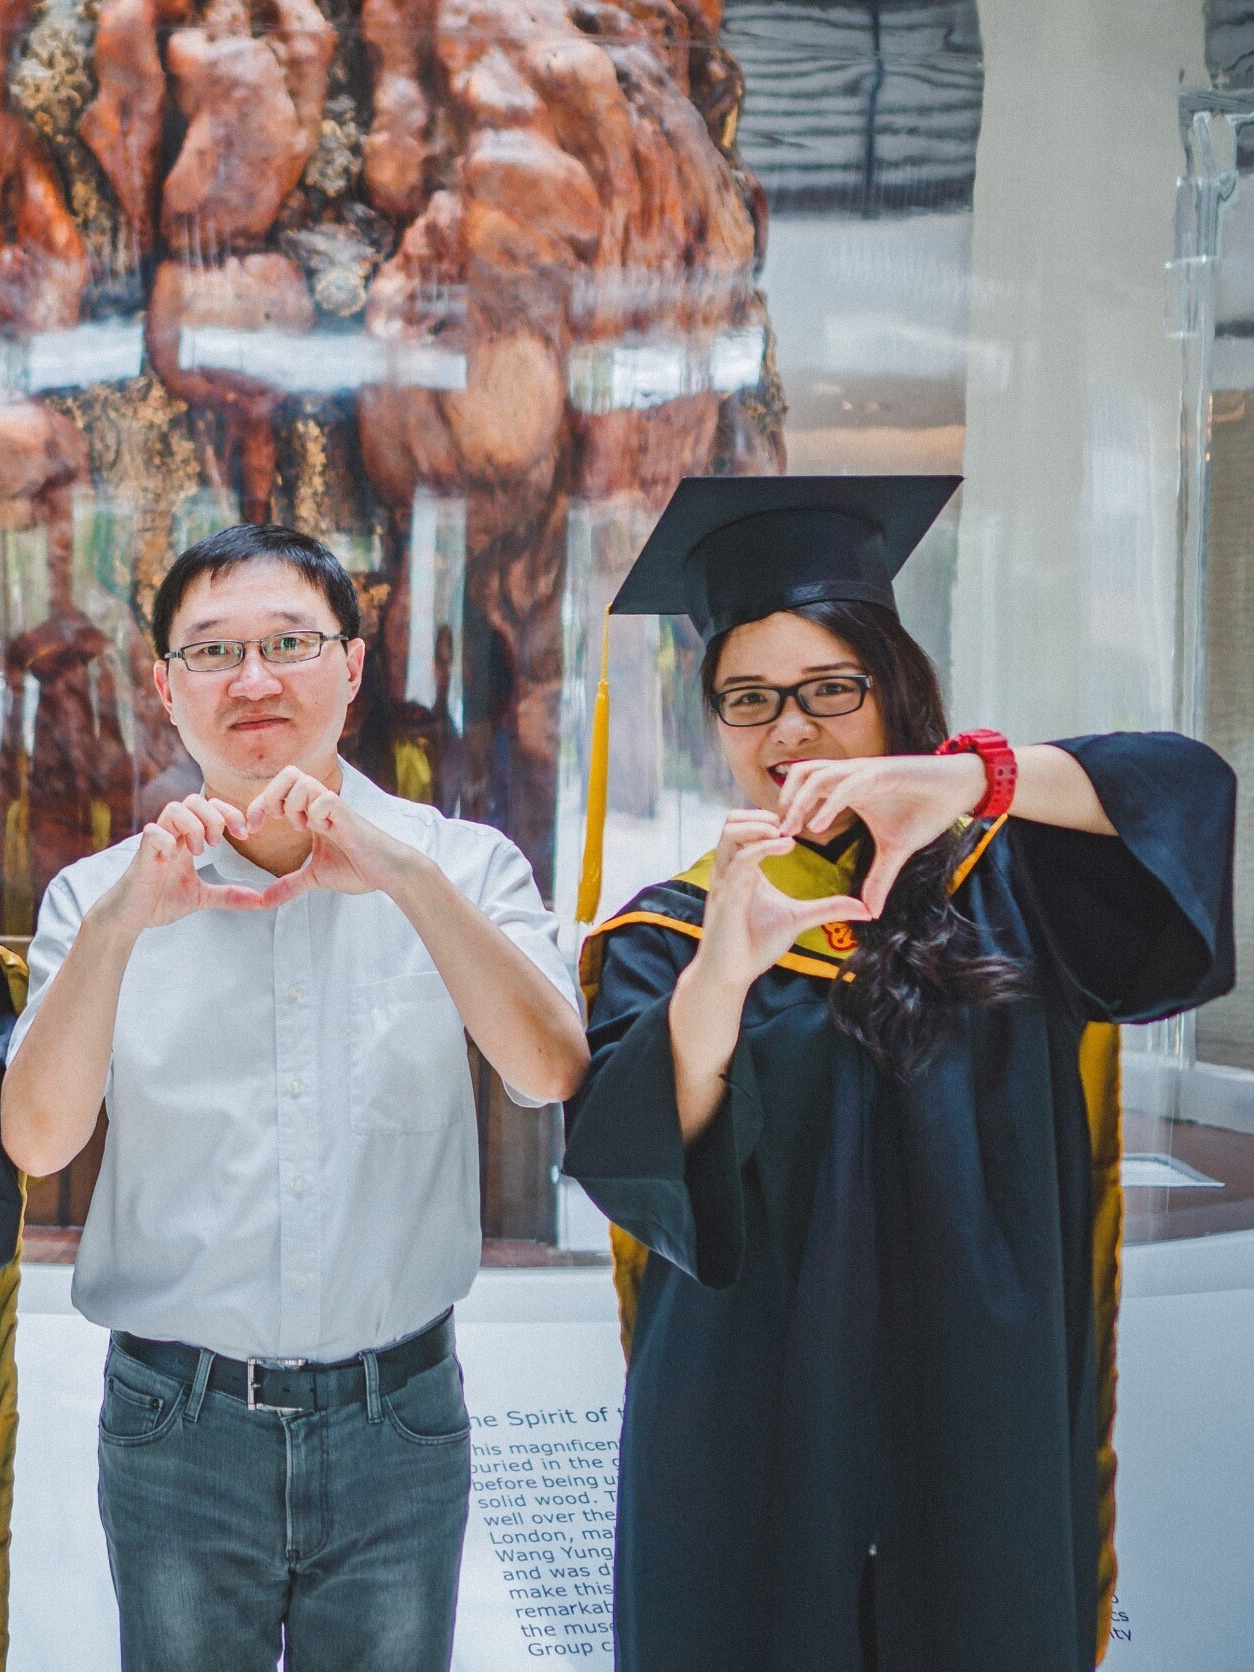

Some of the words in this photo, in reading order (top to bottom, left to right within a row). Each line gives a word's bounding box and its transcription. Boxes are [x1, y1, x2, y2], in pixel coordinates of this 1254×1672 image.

[506, 1409, 578, 1429] Spirit
[585, 1406, 608, 1423] of
[509, 1439, 620, 1456] magnificen
[541, 1458, 561, 1471] in
[568, 1457, 604, 1470] the
[471, 1477, 538, 1492] before
[541, 1475, 599, 1489] being
[478, 1494, 527, 1509] solid
[534, 1491, 598, 1506] wood.
[484, 1512, 524, 1527] well
[531, 1512, 576, 1525] over
[582, 1508, 617, 1522] the
[489, 1529, 574, 1545] London,
[582, 1526, 616, 1540] ma
[495, 1548, 555, 1563] Wang
[560, 1546, 613, 1561] Yung
[503, 1566, 542, 1581] and
[549, 1566, 591, 1578] was
[509, 1584, 568, 1600] make
[574, 1582, 614, 1596] this
[520, 1624, 557, 1638] the
[528, 1641, 594, 1657] Group
